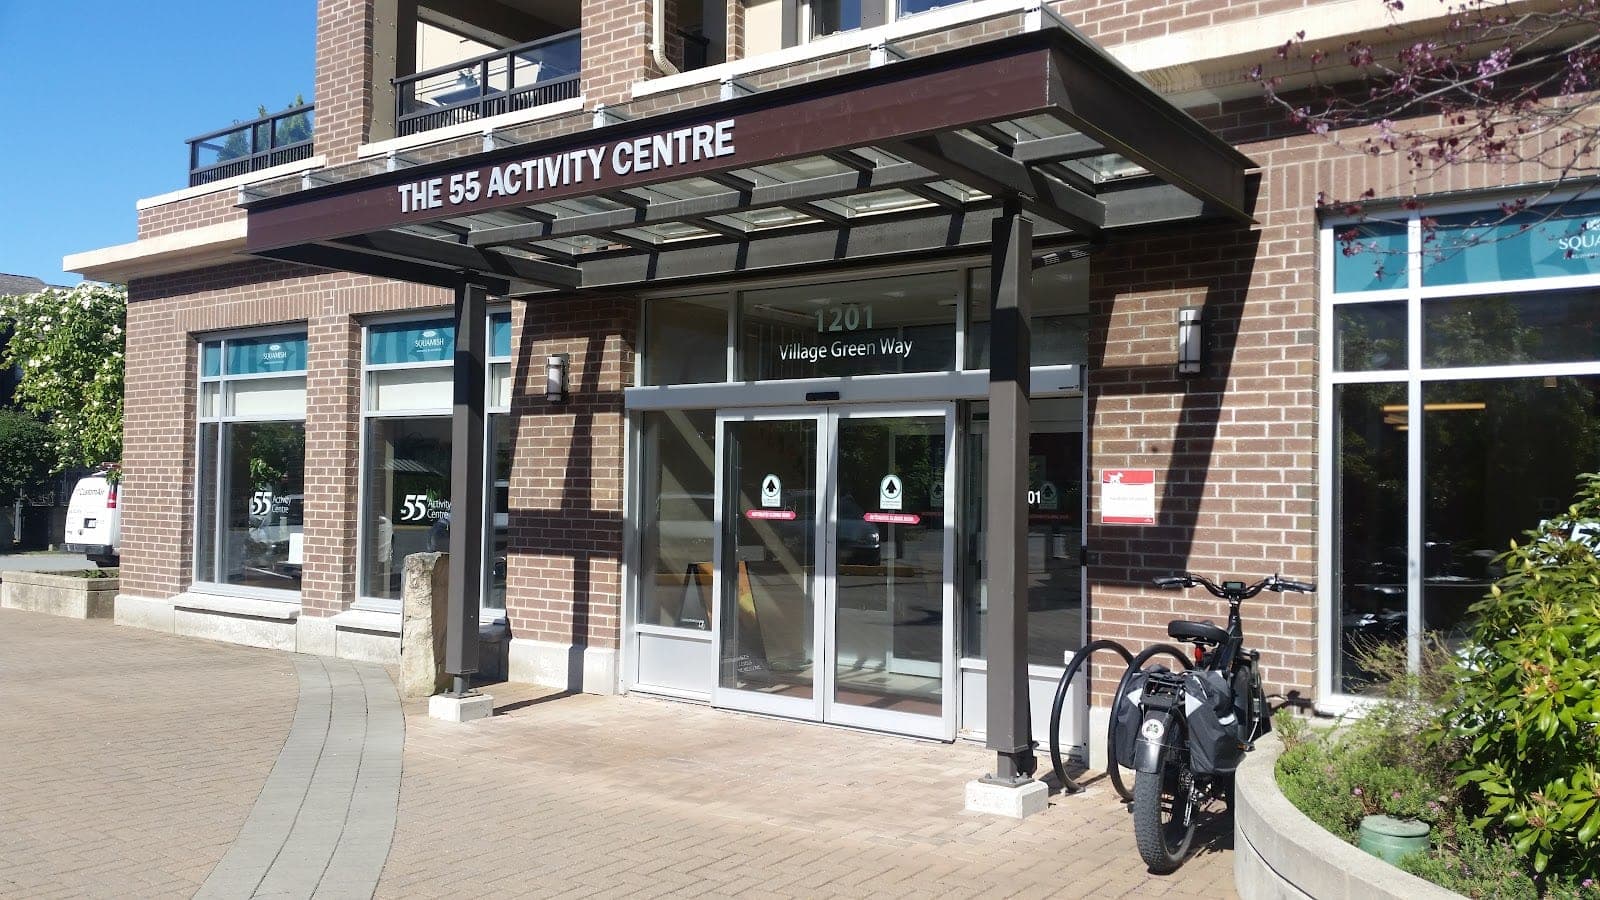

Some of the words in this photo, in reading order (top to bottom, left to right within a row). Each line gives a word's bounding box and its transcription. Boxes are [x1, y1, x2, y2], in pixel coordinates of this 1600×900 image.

[397, 177, 443, 213] THE
[449, 171, 481, 205] 55
[487, 146, 607, 198] ACTIVITY
[612, 119, 736, 175] CENTRE
[814, 303, 873, 333] 1201
[415, 337, 444, 349] SQUAMISH
[779, 343, 828, 363] Village
[830, 340, 876, 358] Green
[879, 337, 913, 358] Way
[251, 491, 273, 515] 55
[401, 494, 427, 520] 55
[426, 508, 449, 519] Centre
[427, 498, 452, 510] Activity
